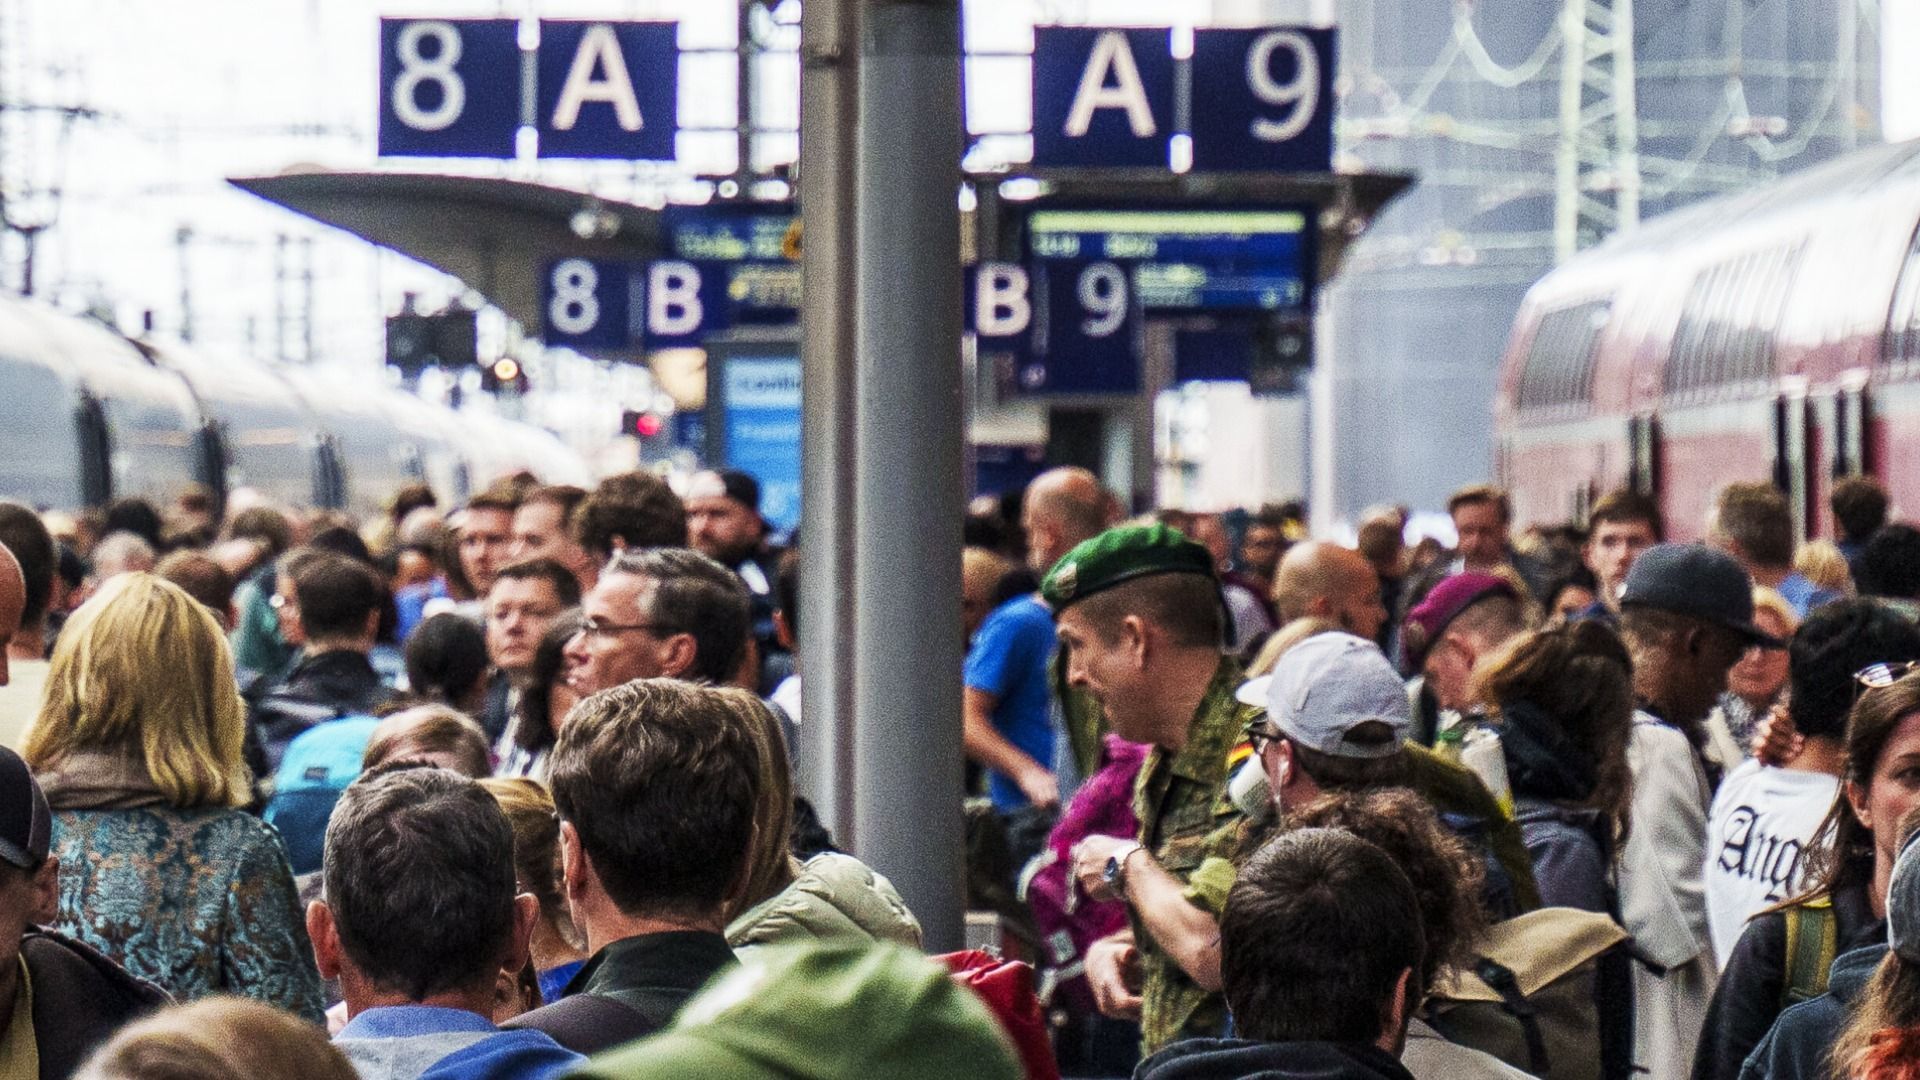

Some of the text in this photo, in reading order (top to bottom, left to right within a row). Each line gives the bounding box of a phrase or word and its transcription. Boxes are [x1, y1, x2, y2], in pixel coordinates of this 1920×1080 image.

[391, 19, 644, 132] 8 A
[1064, 29, 1321, 142] A 9
[548, 259, 598, 335] 8
[647, 259, 703, 336] B
[975, 262, 1032, 337] B
[1077, 261, 1128, 337] 9
[1718, 804, 1808, 902] Ang
